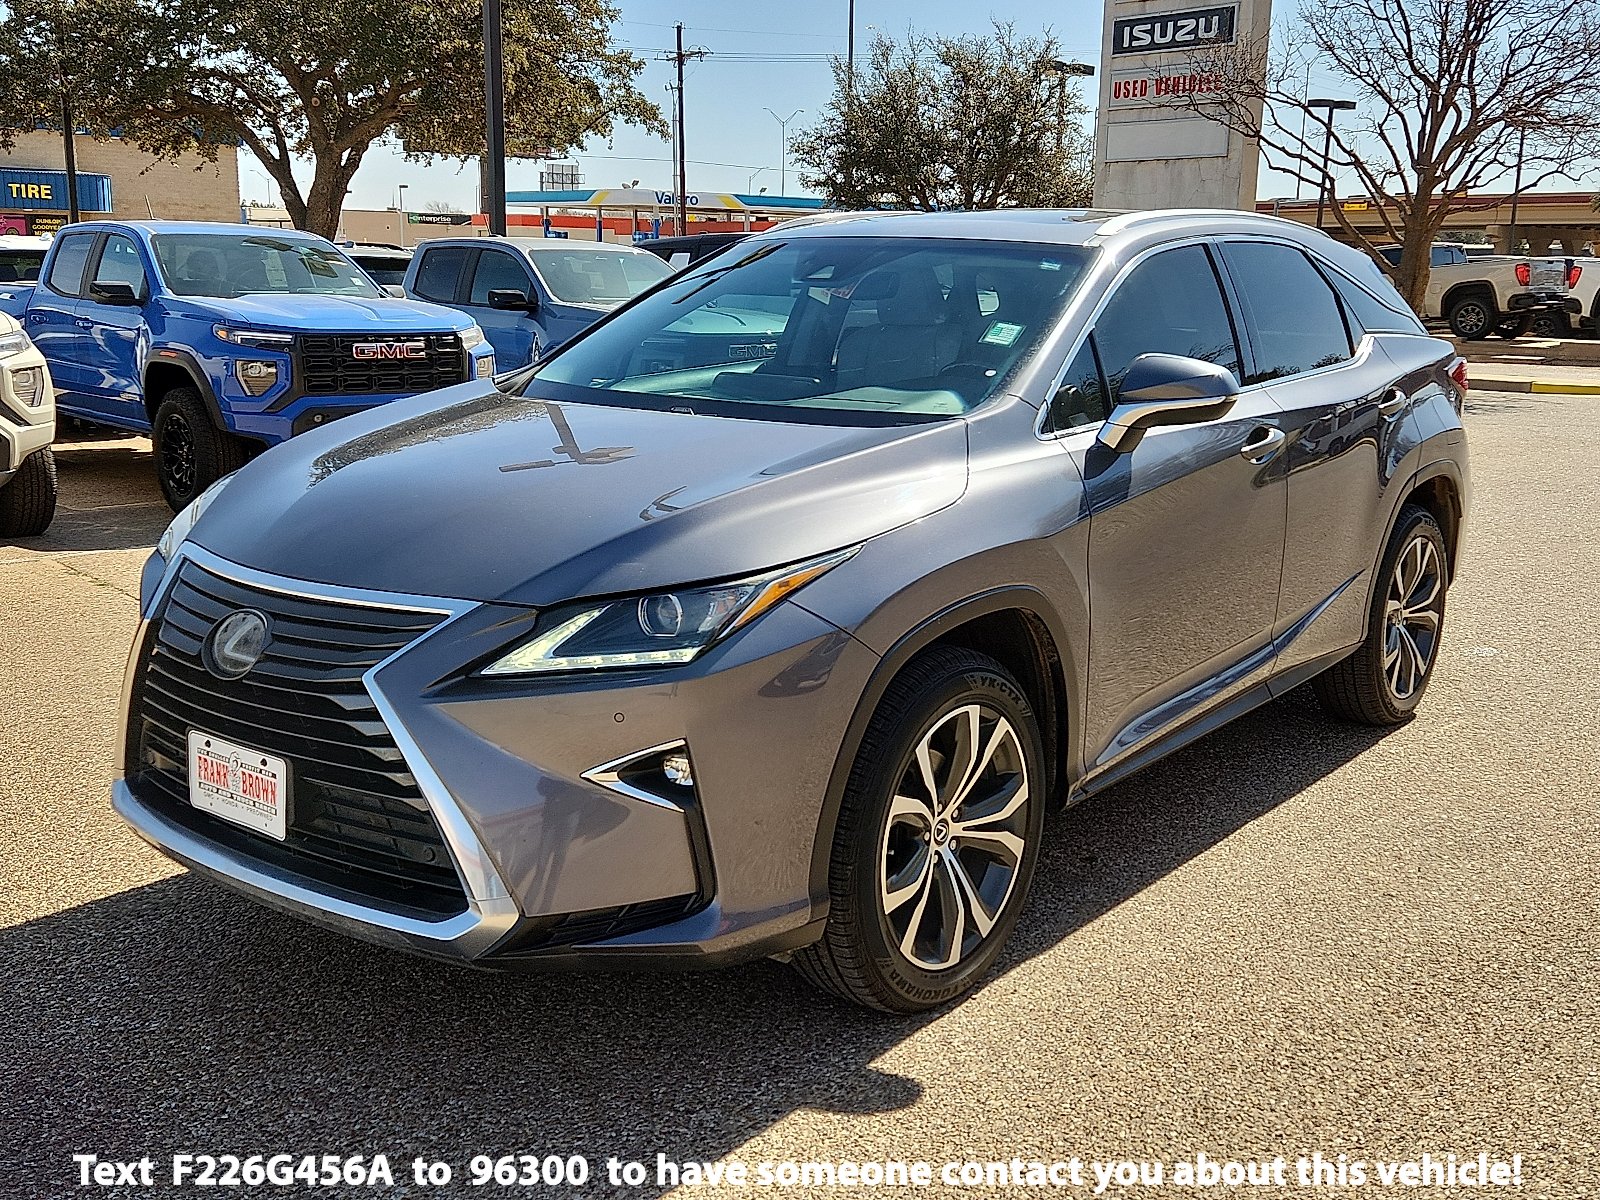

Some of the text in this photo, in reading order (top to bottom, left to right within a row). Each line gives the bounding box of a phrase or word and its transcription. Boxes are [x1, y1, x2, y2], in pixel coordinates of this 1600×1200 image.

[1122, 15, 1220, 48] ISUZU
[1113, 79, 1148, 100] USED
[7, 183, 53, 200] TIRE
[353, 341, 426, 360] GMC
[197, 755, 229, 789] FRANK
[241, 770, 277, 806] BROWN
[889, 967, 960, 1001] YOKOHAMA
